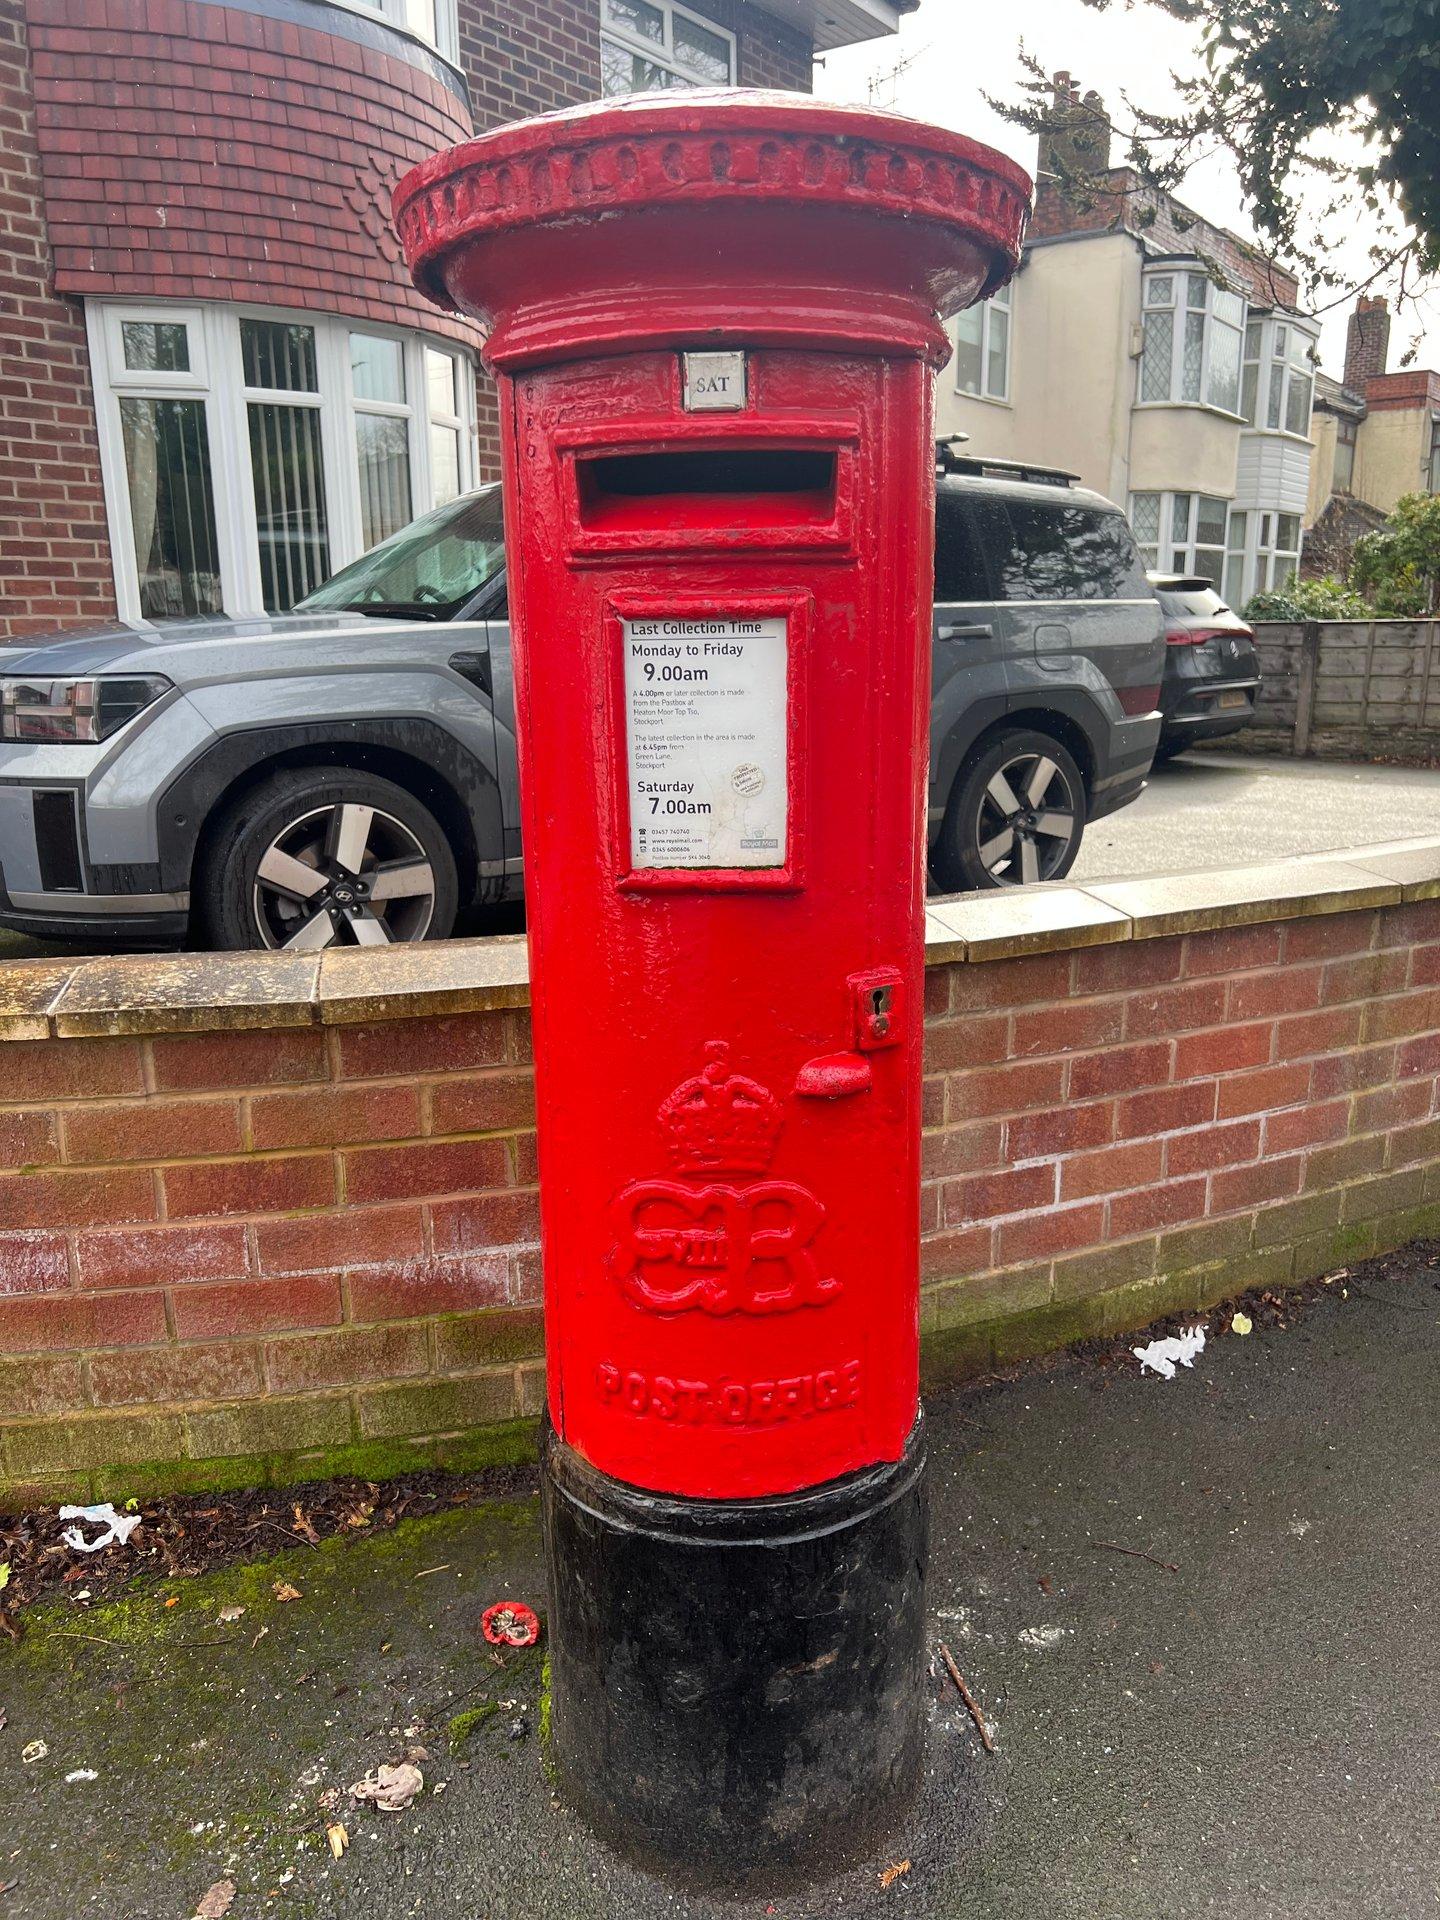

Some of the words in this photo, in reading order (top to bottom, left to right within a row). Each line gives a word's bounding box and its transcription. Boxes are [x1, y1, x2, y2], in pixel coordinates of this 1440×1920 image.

[697, 376, 730, 393] SAT
[631, 623, 659, 635] Last
[663, 621, 725, 635] Collection
[729, 621, 762, 634] Time
[632, 644, 681, 658] Monday
[686, 645, 699, 656] to
[704, 643, 744, 657] Friday
[643, 662, 708, 681] 9.00am
[639, 690, 664, 699] 4.00pm
[674, 689, 688, 697] later
[675, 708, 687, 716] Top
[634, 718, 664, 726] Stockport
[643, 743, 668, 752] 6.45pm
[636, 762, 666, 770] Stockport
[637, 781, 694, 794] Saturday
[648, 797, 712, 815] 7.00am
[742, 840, 760, 848] Royal
[598, 1359, 709, 1424] POST
[722, 1359, 860, 1424] OFFICE
